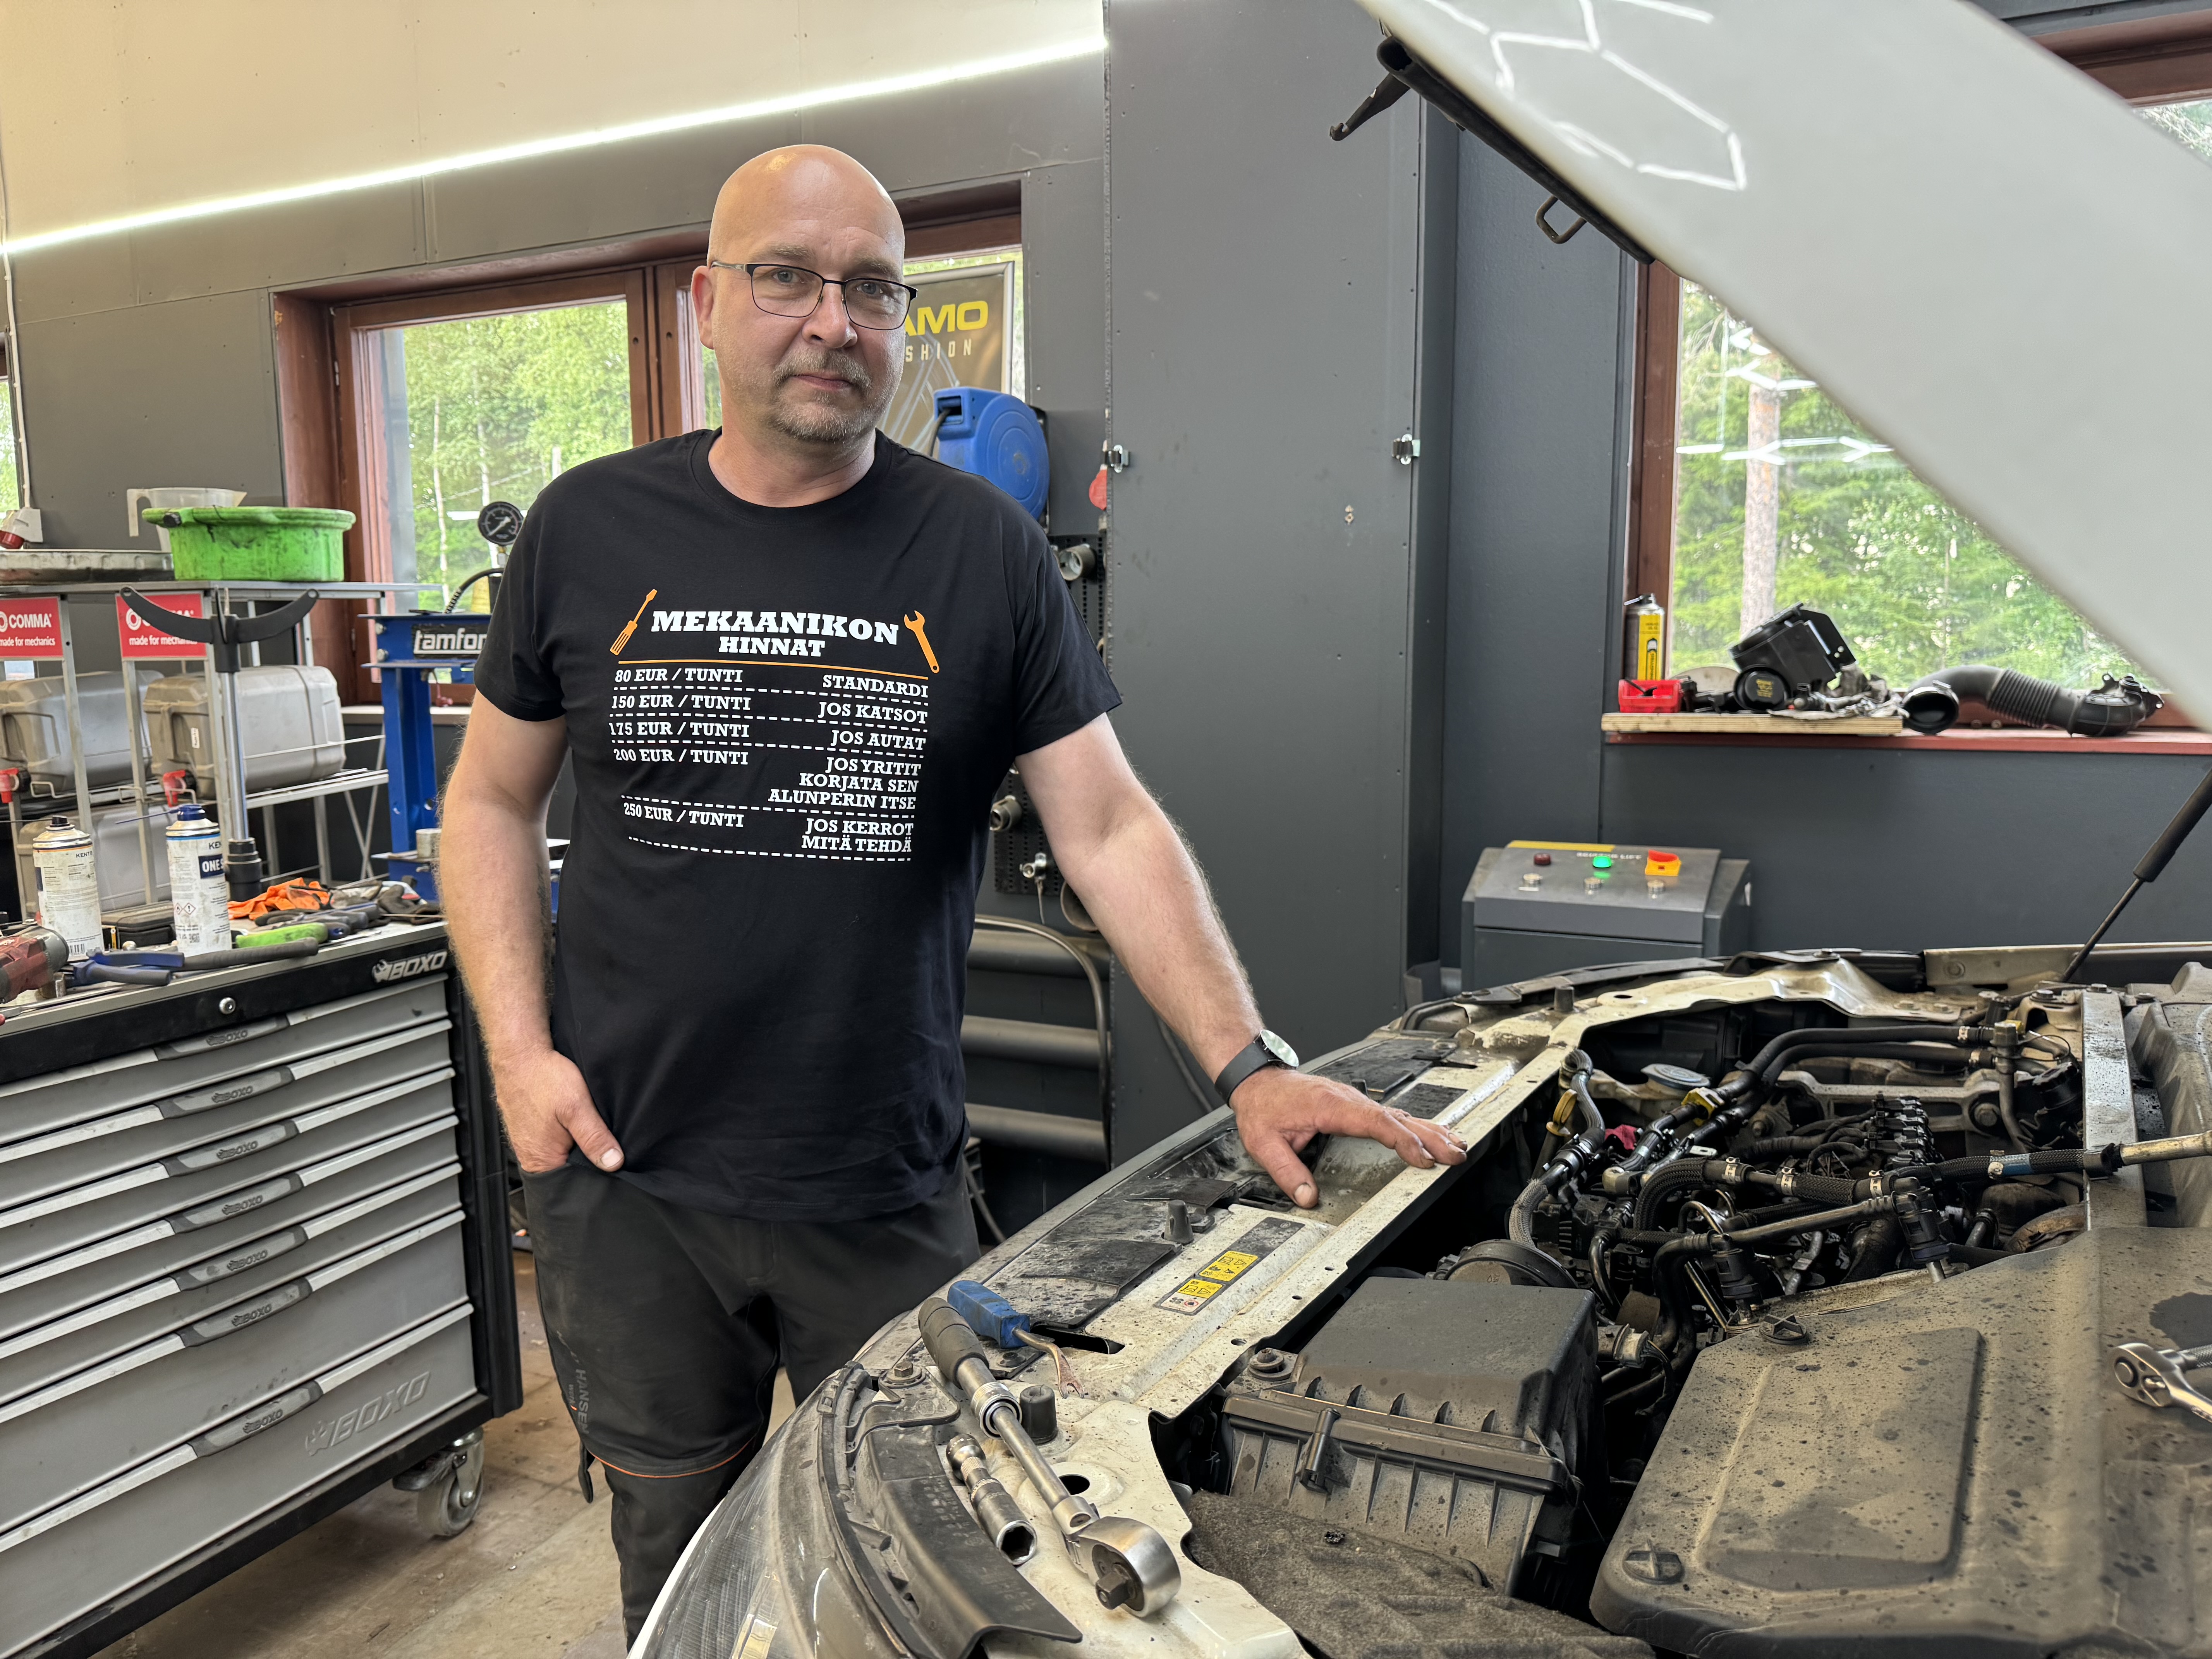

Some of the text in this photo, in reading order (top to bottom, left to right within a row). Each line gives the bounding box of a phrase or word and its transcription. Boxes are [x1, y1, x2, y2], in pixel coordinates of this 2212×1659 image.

[905, 338, 972, 362] SHION
[9, 613, 52, 629] COMMA
[651, 611, 899, 646] MEKAANIKON
[0, 636, 55, 646] made for mechanics
[129, 635, 148, 645] made
[149, 635, 159, 645] for
[719, 636, 825, 657] HINNAT
[615, 670, 631, 682] 80
[634, 668, 668, 681] EUR
[685, 668, 743, 682] TUNTI
[822, 674, 928, 698] STANDARDI
[612, 696, 635, 709] 150
[639, 695, 674, 708] EUR
[691, 695, 751, 710] TUNTI
[818, 702, 928, 725] JOS KATSOT
[609, 722, 632, 735] 175
[637, 722, 673, 735] EUR
[690, 722, 749, 737] TUNTI
[831, 730, 926, 750] JOS AUTAT
[614, 749, 636, 761] 200
[641, 749, 675, 762] EUR
[690, 750, 748, 764] TUNTI
[825, 757, 921, 776] JOS YRITIT
[799, 773, 919, 792] KORJATA SEN
[768, 789, 916, 809] ALUNPERIN ITSE
[624, 802, 642, 817] 250
[644, 806, 673, 821] EUR
[689, 811, 744, 827] TUNTI
[805, 818, 914, 836] JOS KERROT
[802, 835, 911, 852] MITÄ TEHDÄ
[388, 951, 447, 981] BOXO
[331, 1371, 430, 1447] BOXO
[576, 1369, 589, 1434] HANSEN
